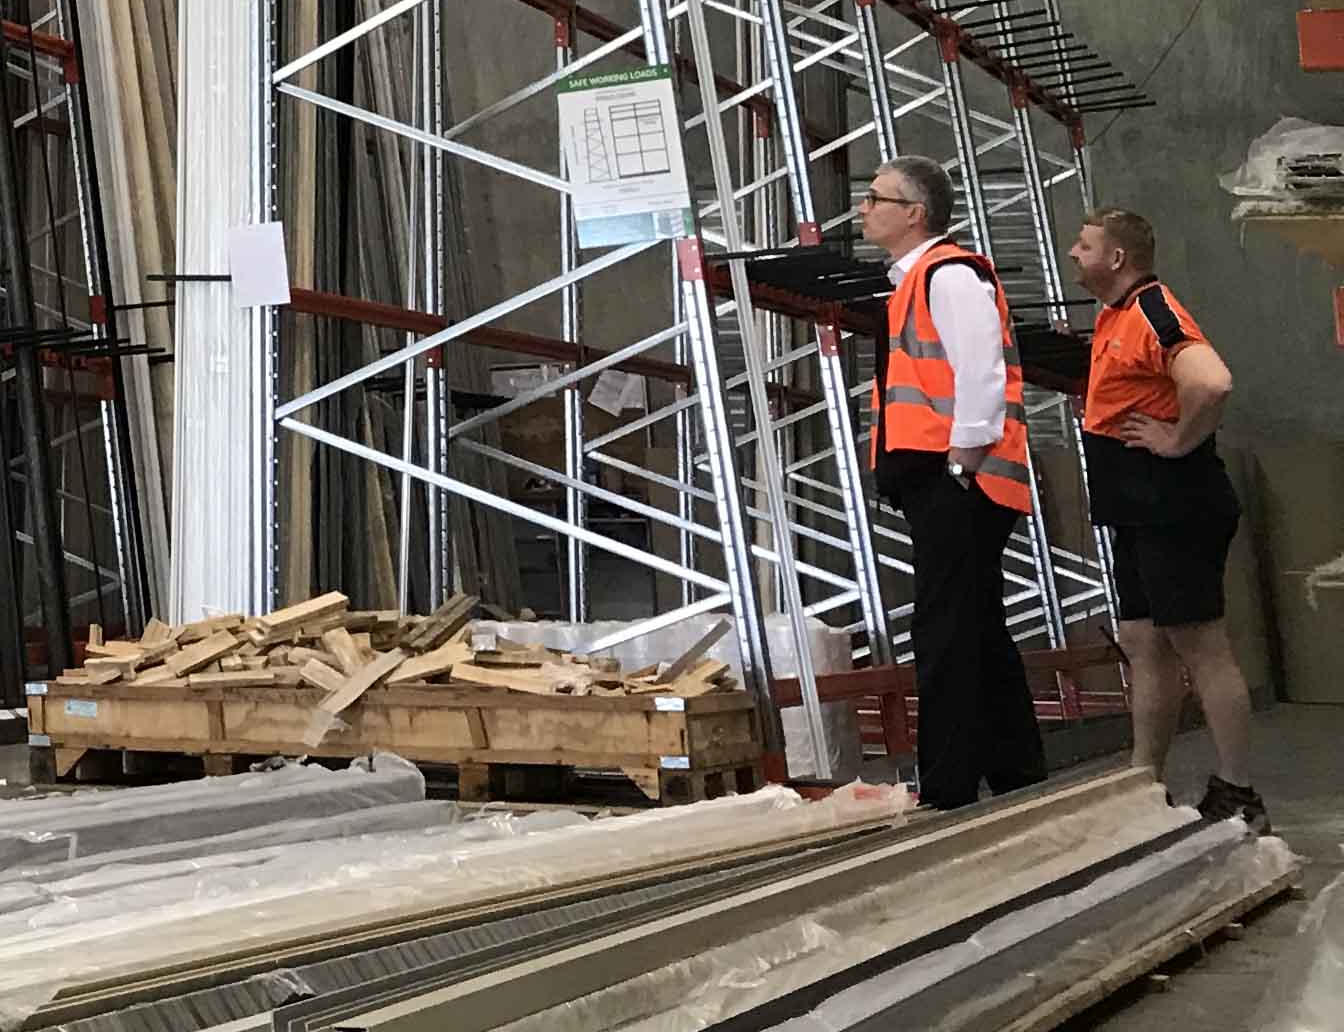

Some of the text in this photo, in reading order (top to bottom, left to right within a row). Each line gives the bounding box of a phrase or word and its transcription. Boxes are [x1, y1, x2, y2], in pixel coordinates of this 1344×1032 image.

[569, 68, 657, 88] SAFE WORKING LOADS
